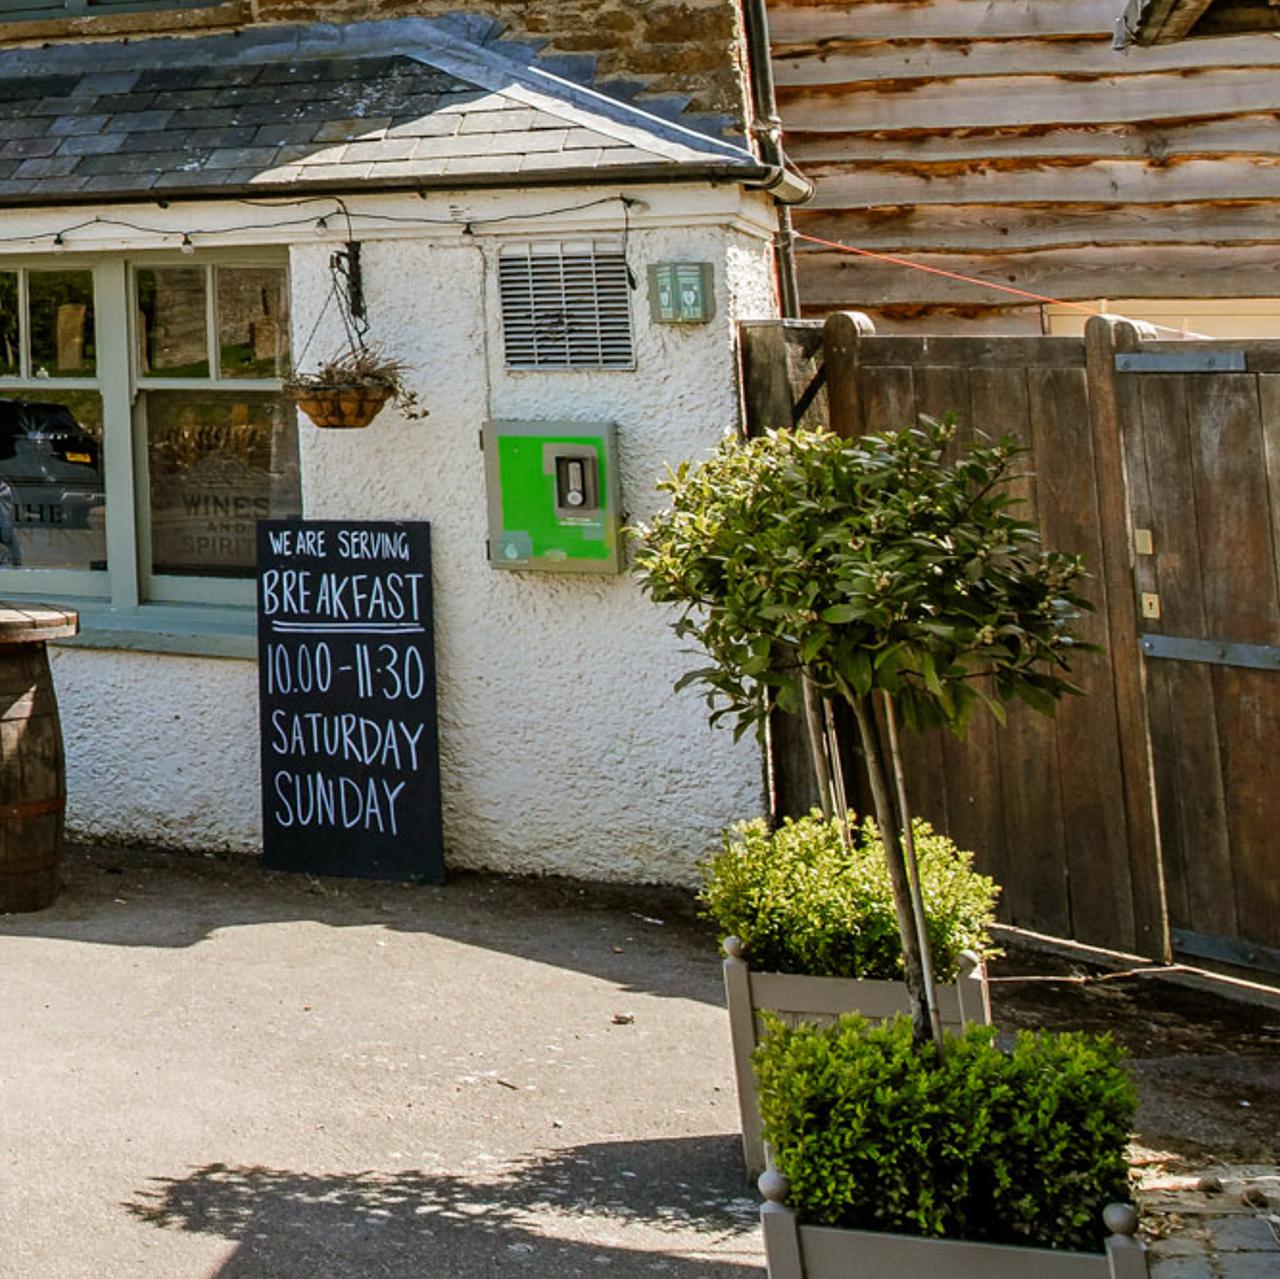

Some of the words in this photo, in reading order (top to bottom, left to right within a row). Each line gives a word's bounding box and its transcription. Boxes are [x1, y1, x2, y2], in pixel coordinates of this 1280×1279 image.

[11, 503, 64, 524] THE
[182, 494, 270, 517] WINES
[206, 521, 246, 535] AND
[268, 530, 291, 556] WE
[295, 530, 327, 558] ARE
[338, 530, 410, 561] SERVING
[262, 569, 424, 621] BREAKFAST
[272, 709, 425, 771] SATURDAY
[274, 771, 406, 836] SUNDAY
